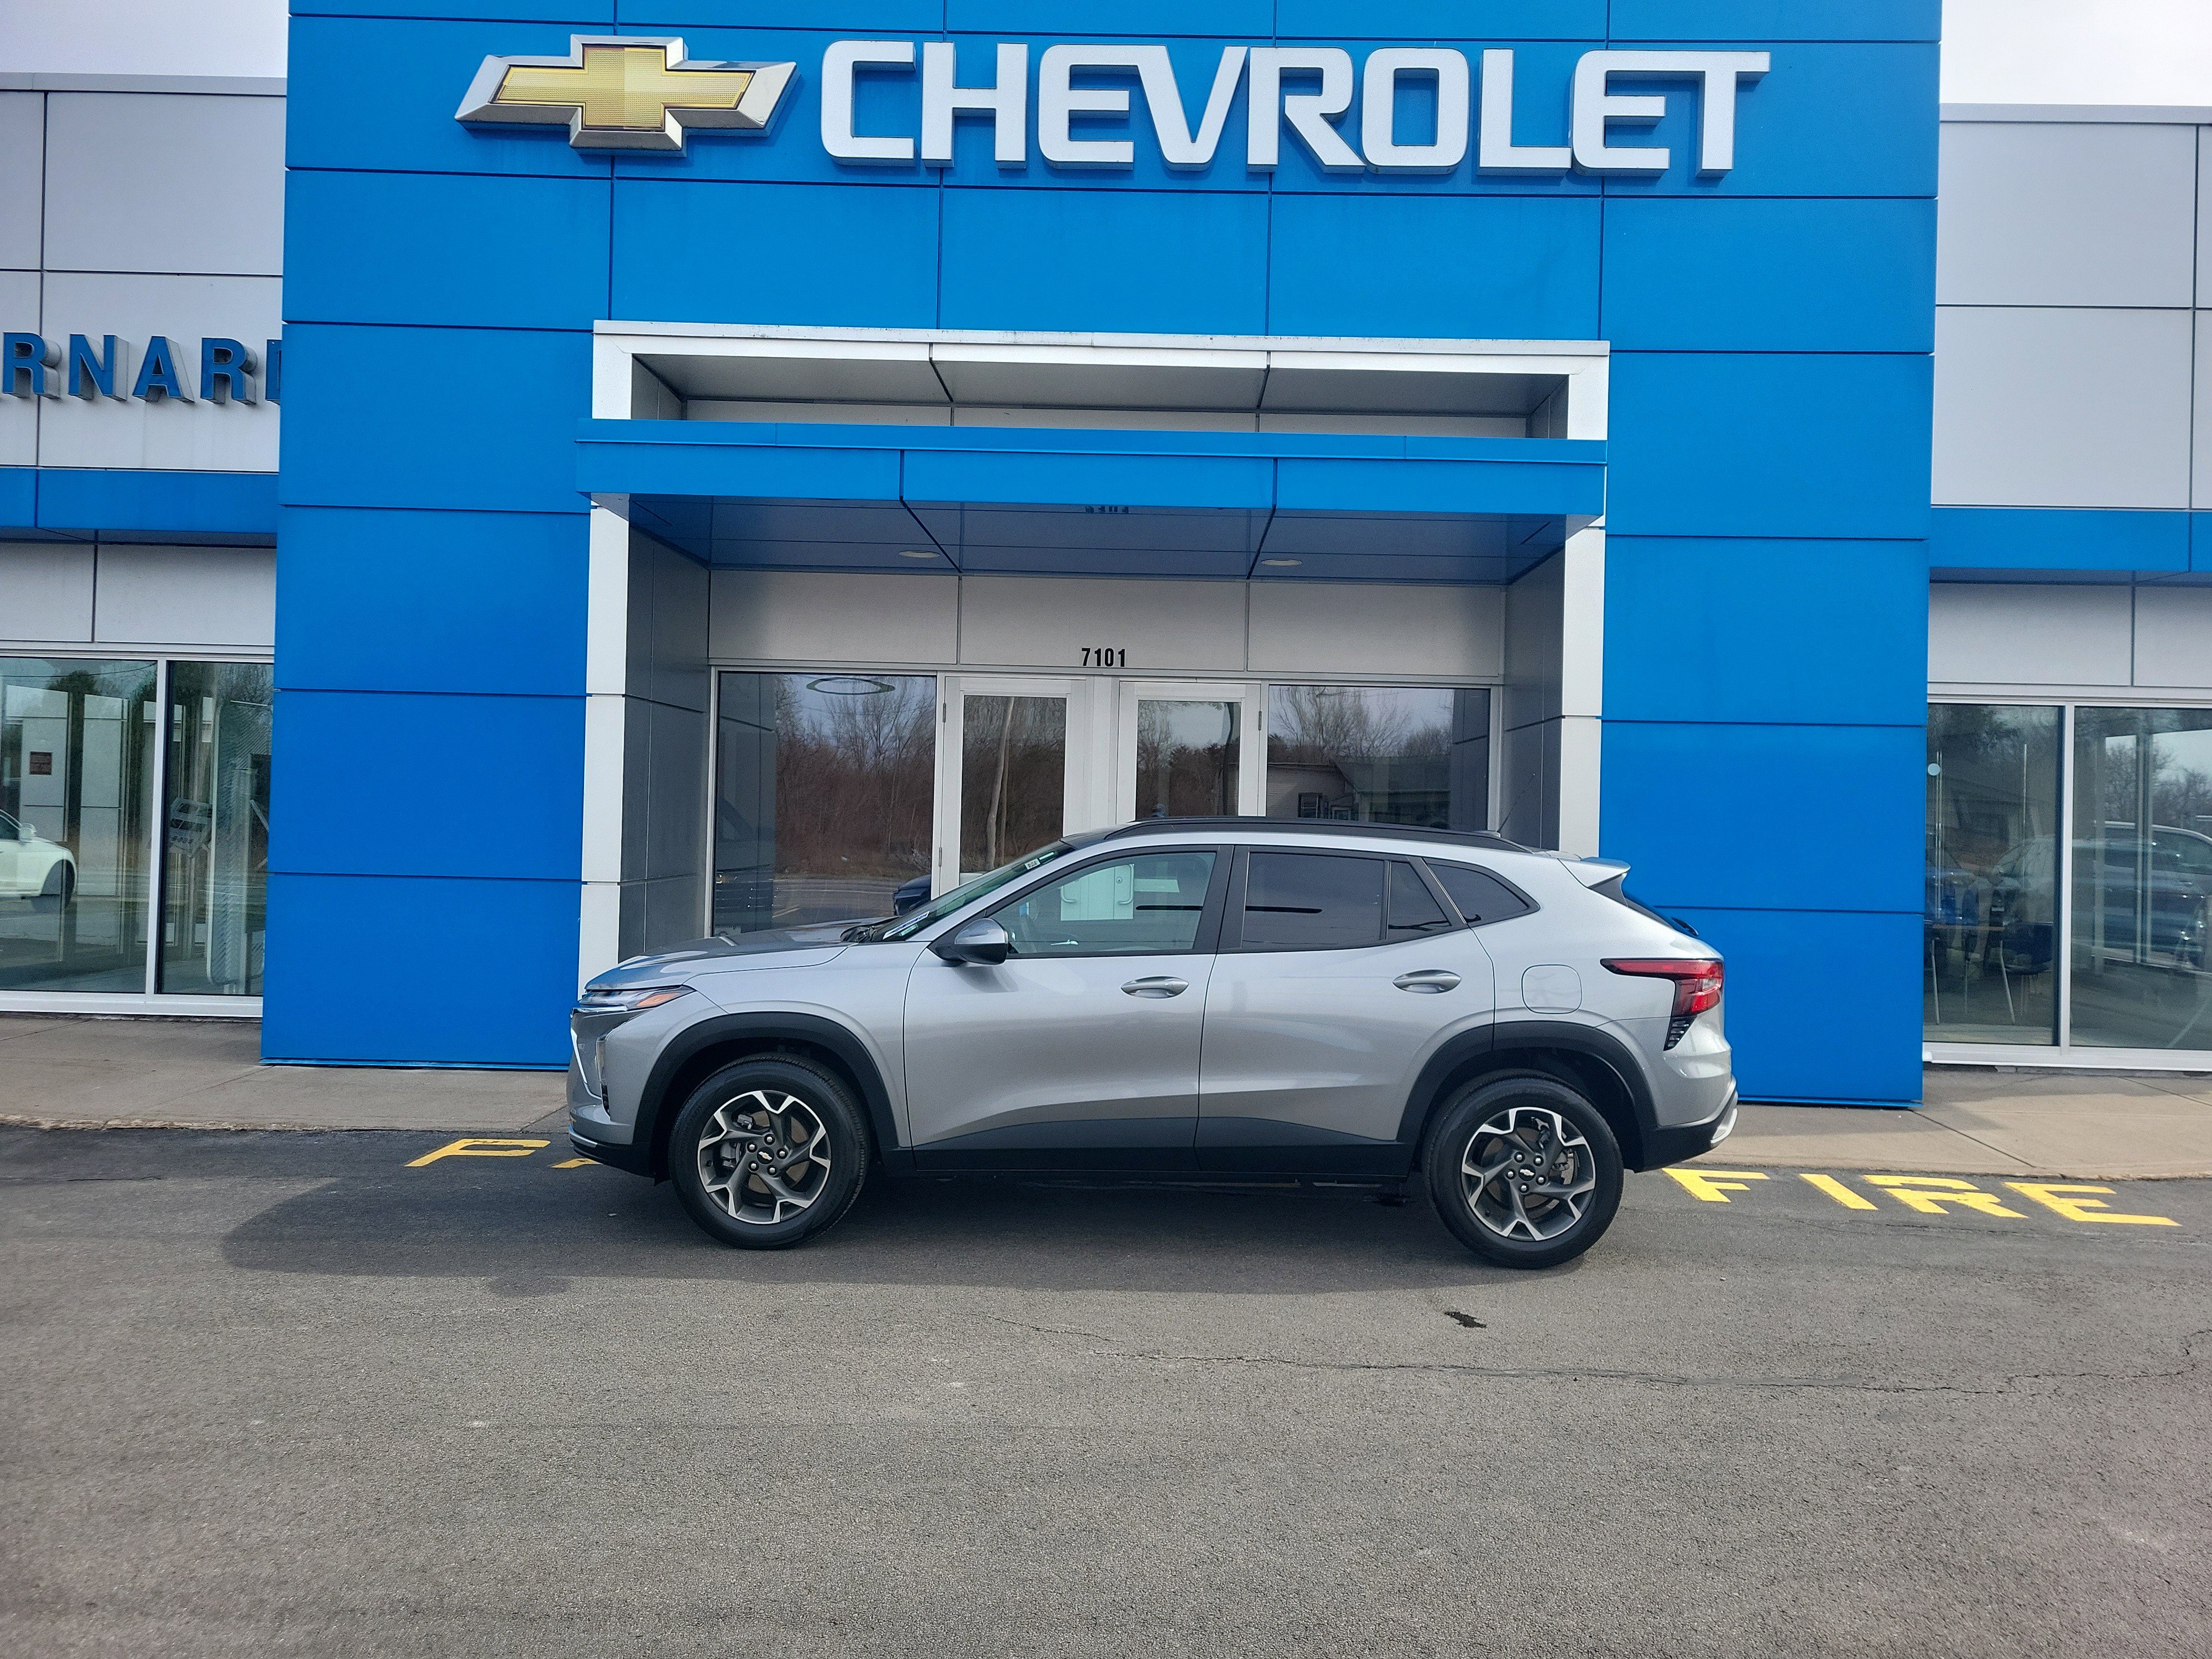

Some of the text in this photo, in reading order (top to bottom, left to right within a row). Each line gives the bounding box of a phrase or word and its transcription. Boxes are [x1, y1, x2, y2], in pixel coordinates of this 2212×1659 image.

[821, 39, 1771, 178] CHEVROLET
[1081, 648, 1126, 667] 7101
[1661, 1167, 2183, 1226] FIRE
